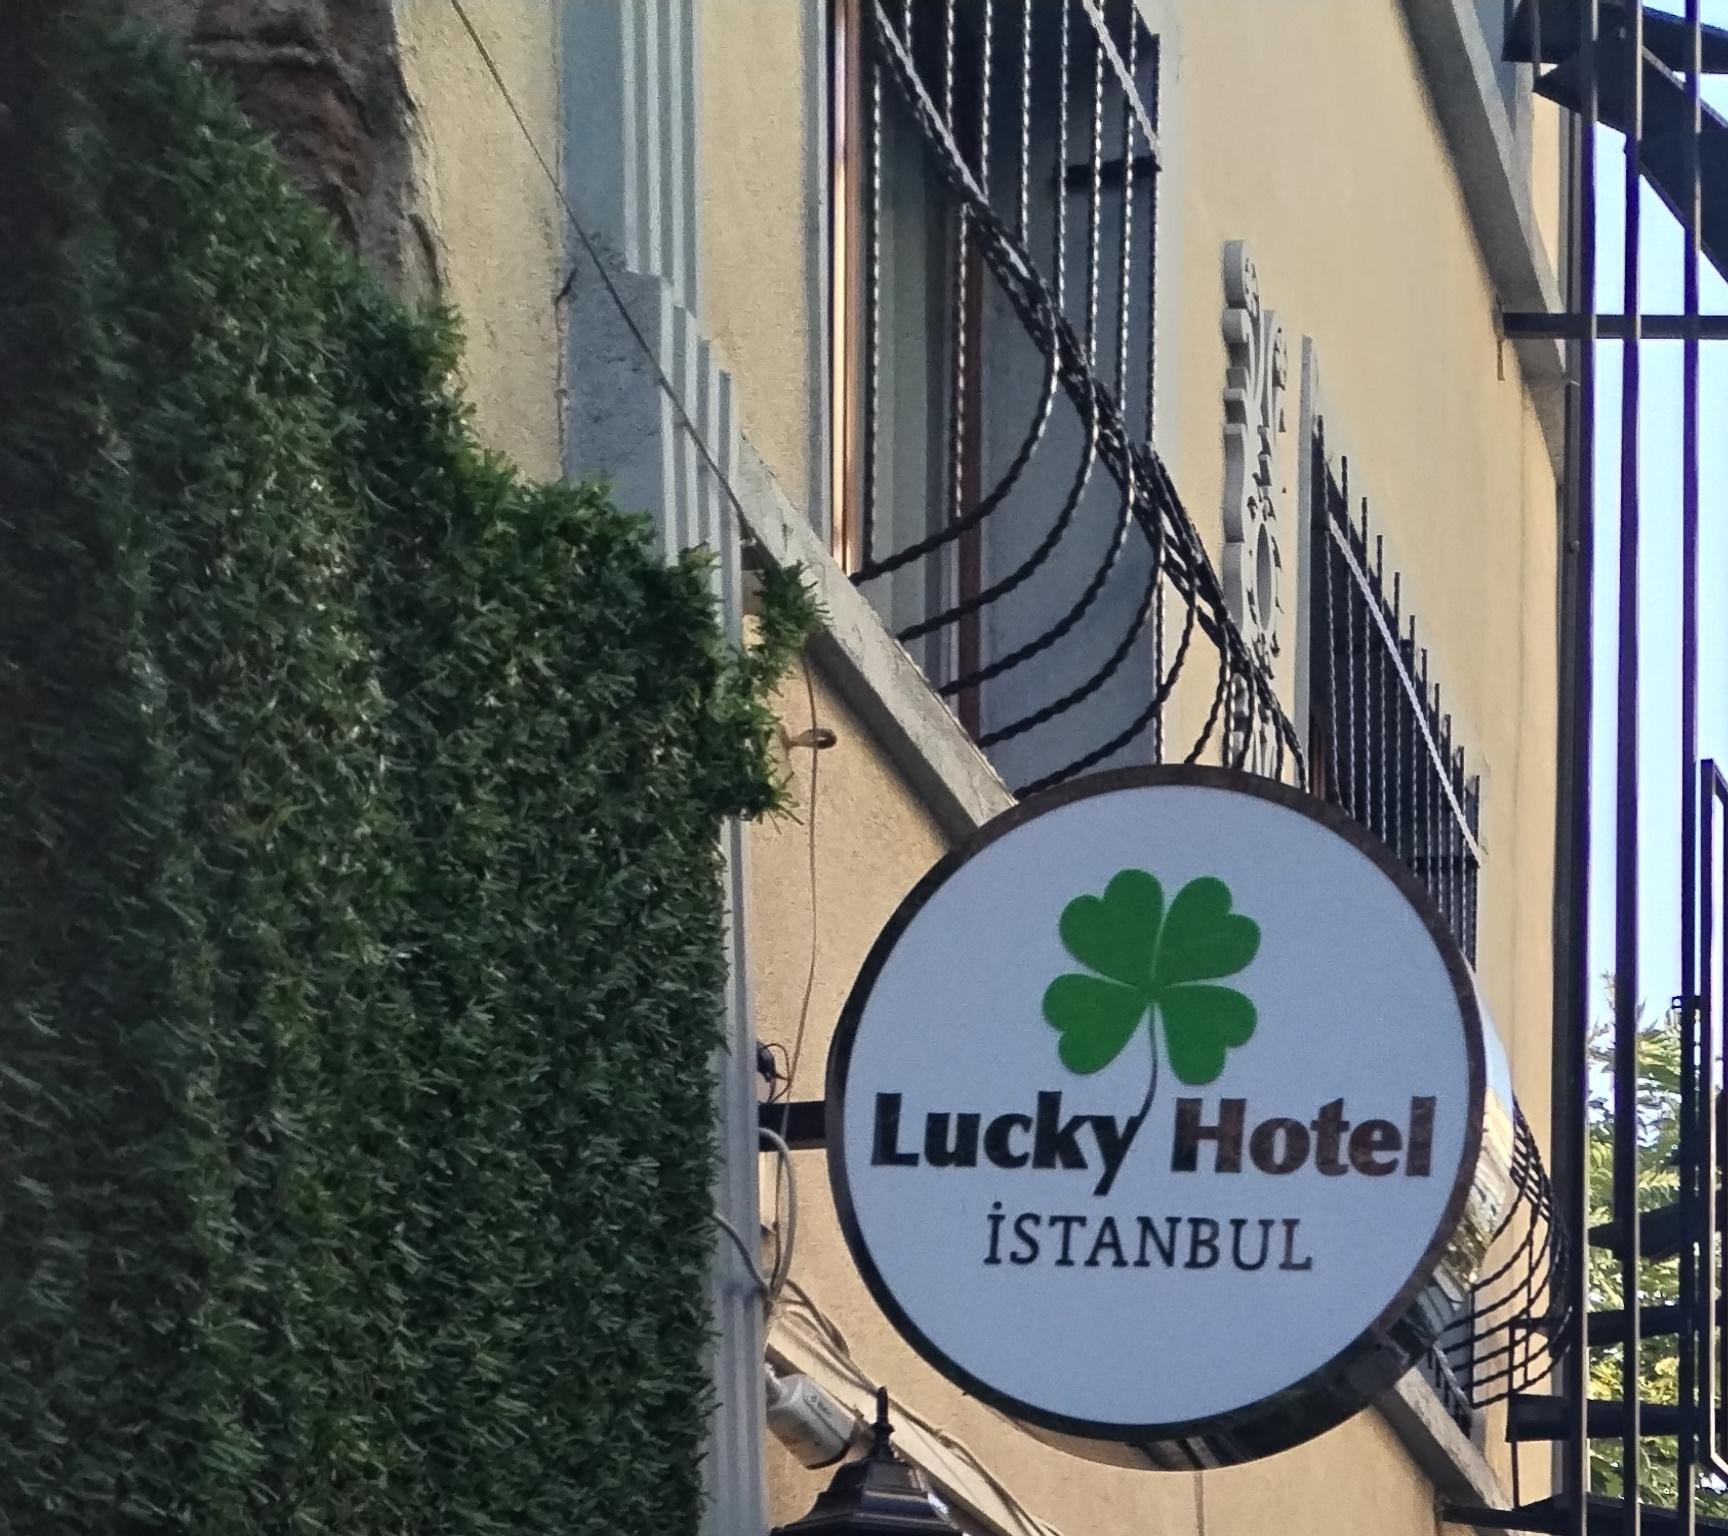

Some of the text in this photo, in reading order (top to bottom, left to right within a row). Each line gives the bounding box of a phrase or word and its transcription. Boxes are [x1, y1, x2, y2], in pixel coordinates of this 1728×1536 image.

[870, 1091, 1437, 1196] Lucky Hotel
[983, 1201, 1313, 1272] İSTANBUL
